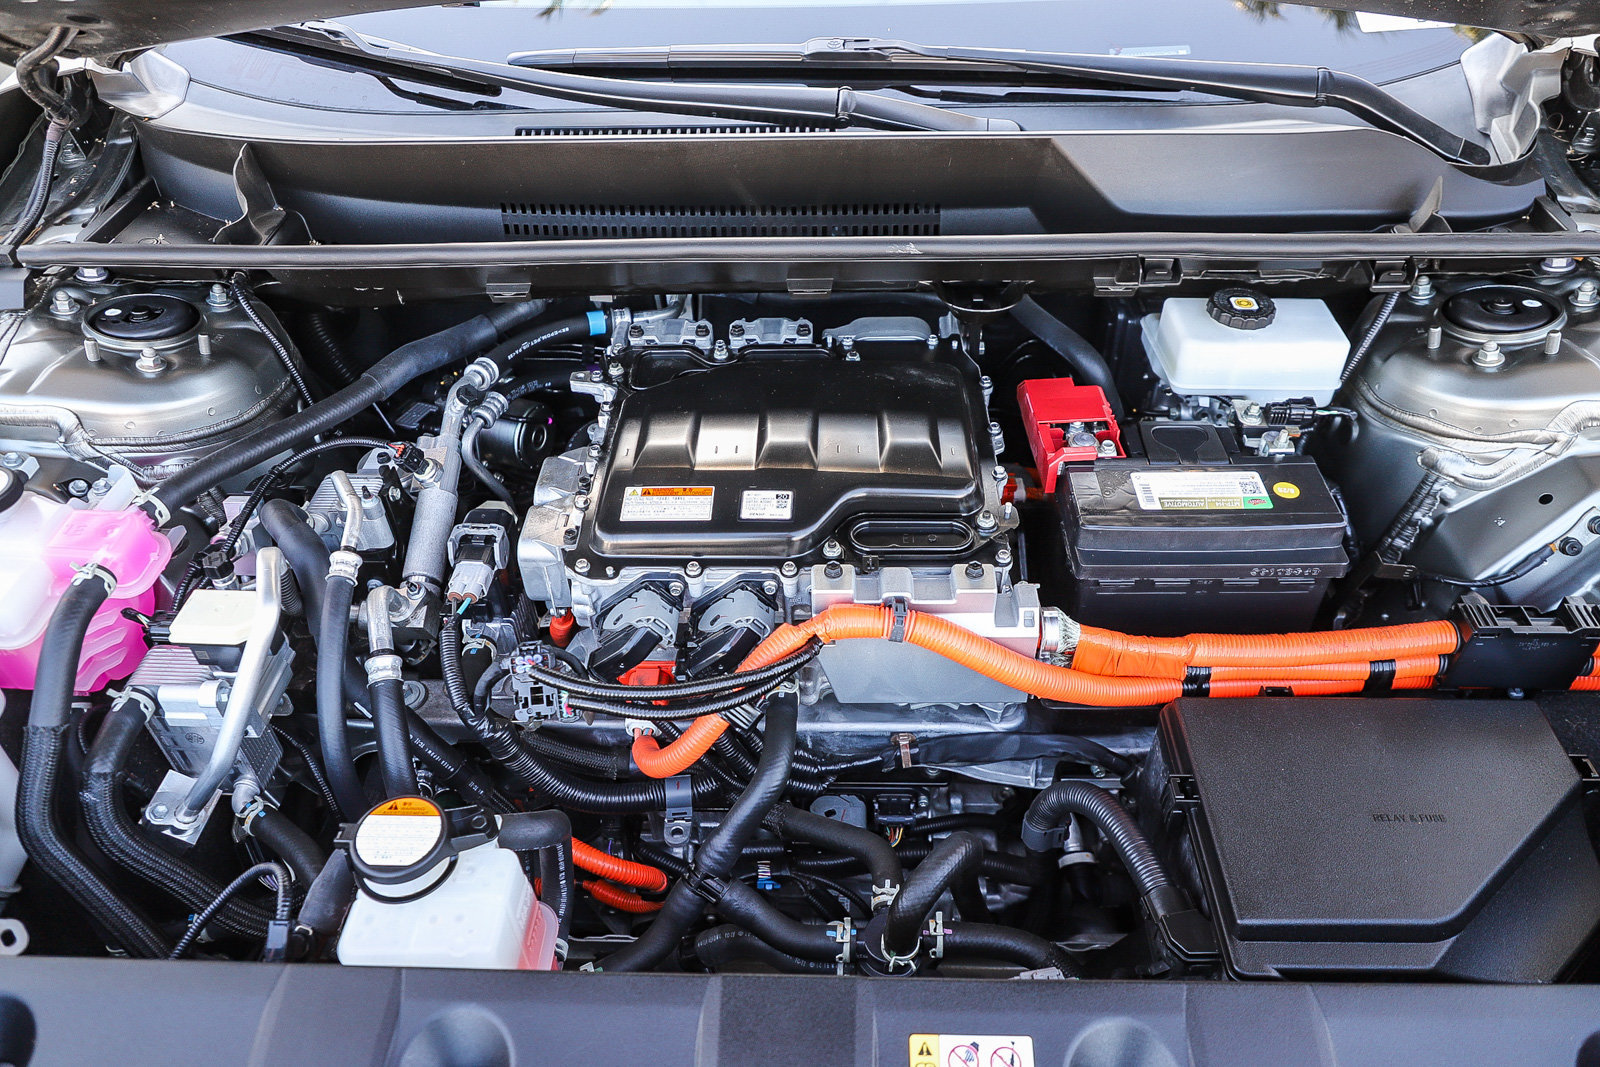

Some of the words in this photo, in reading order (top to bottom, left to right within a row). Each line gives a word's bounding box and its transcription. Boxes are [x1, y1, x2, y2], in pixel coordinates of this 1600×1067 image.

[1372, 813, 1406, 823] RELAY
[1409, 814, 1418, 823] &
[1418, 813, 1447, 823] FUSE
